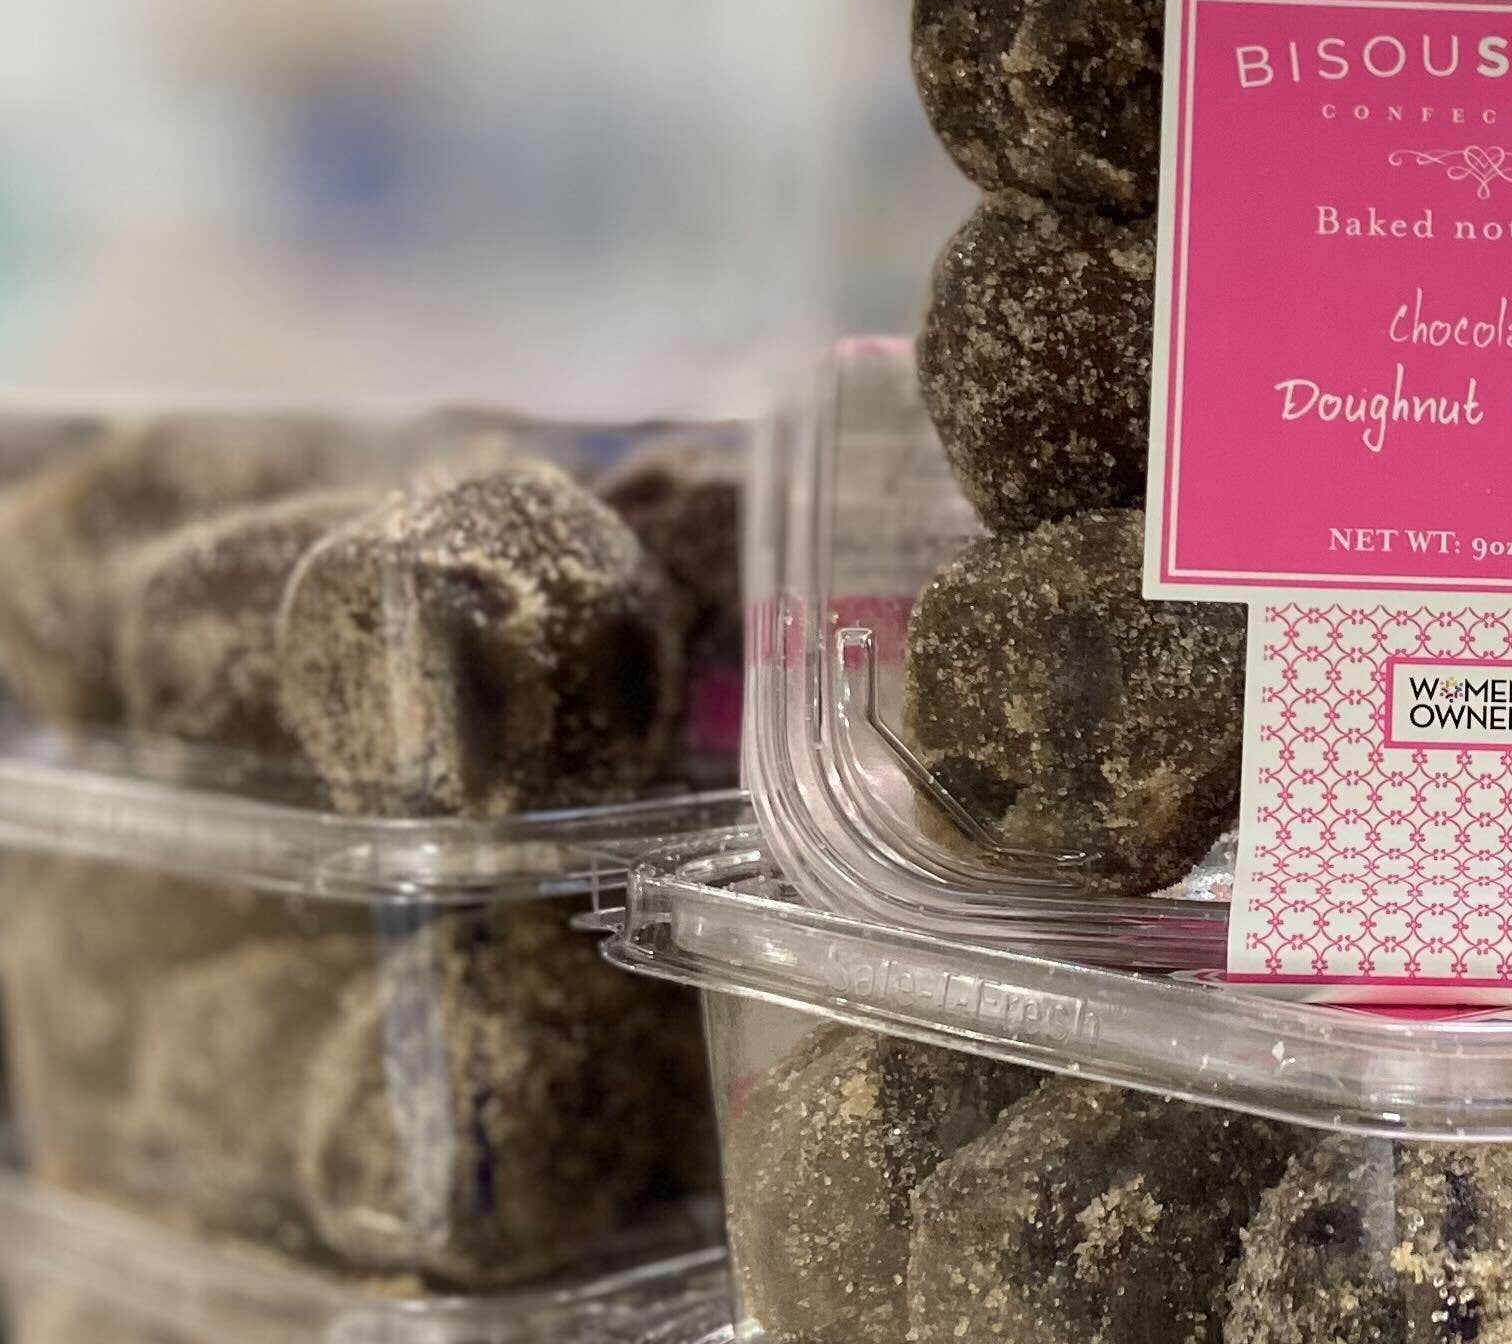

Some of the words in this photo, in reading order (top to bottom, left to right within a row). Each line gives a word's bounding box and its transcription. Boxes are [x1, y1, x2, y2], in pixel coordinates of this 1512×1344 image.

[1314, 205, 1435, 239] Baked
[1273, 362, 1485, 453] Doughnut
[1328, 527, 1399, 553] NET
[1404, 529, 1461, 555] WT:
